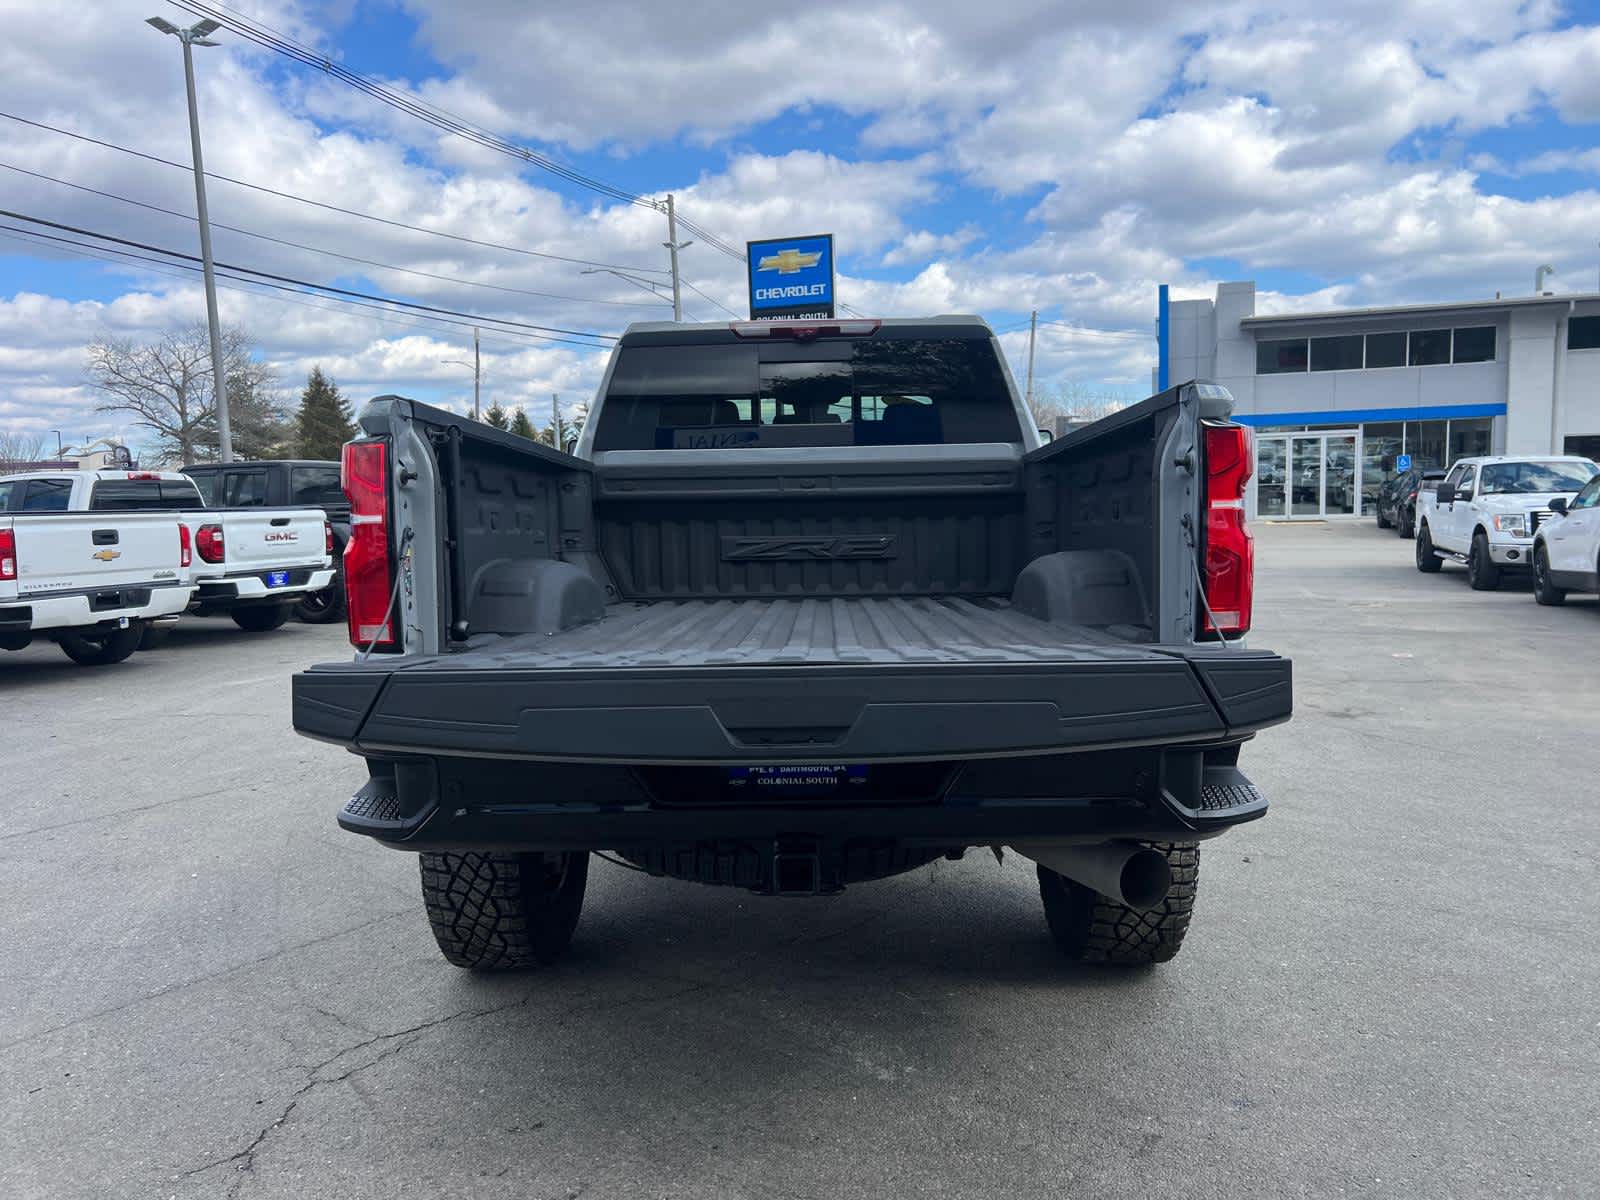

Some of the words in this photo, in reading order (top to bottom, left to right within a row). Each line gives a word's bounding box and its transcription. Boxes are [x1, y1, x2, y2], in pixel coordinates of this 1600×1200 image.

[755, 284, 826, 300] CHEVROLET
[799, 312, 828, 320] SOUTH
[264, 532, 299, 541] GMC
[757, 777, 805, 785] COLONIAL
[806, 776, 838, 784] SOUTH
